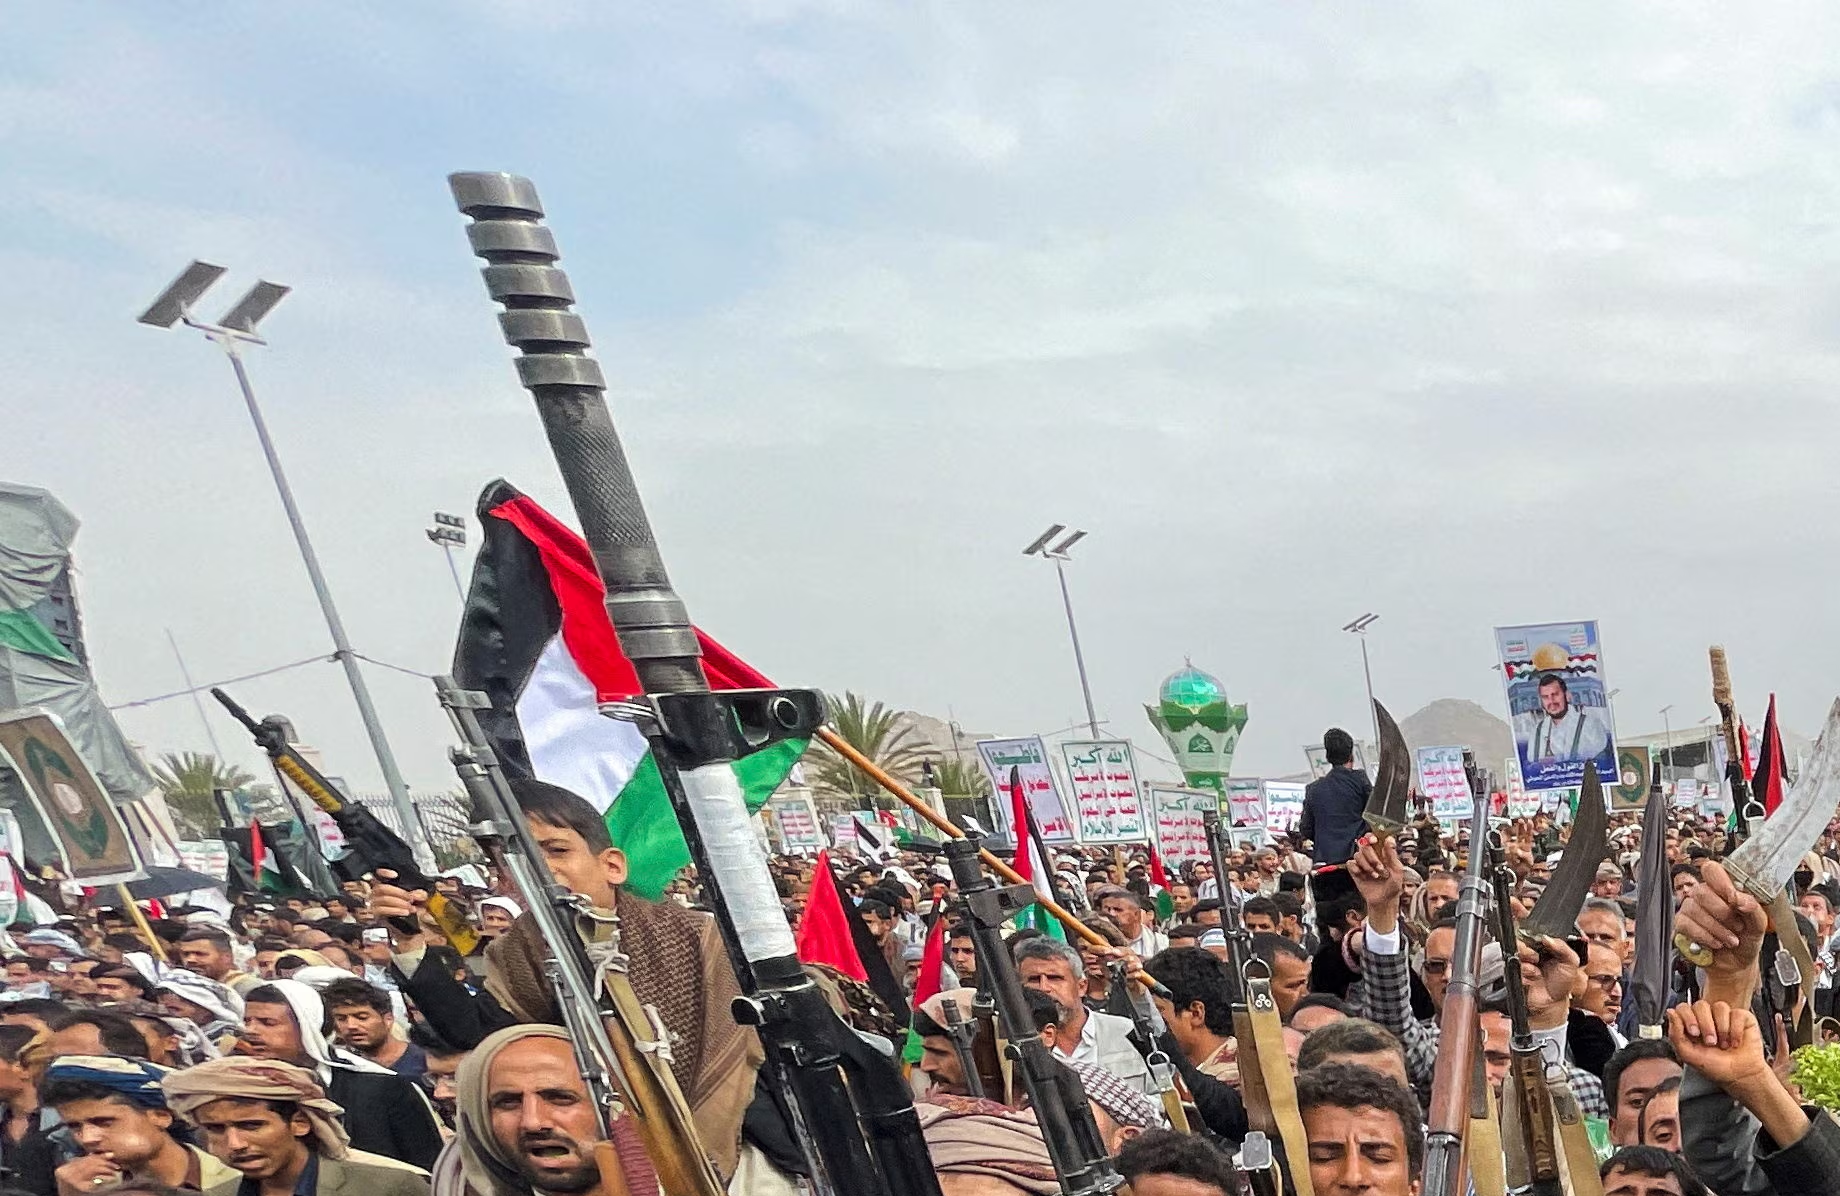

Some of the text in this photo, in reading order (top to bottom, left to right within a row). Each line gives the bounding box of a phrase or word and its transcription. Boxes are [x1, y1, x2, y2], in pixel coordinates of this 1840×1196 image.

[1071, 745, 1128, 768] الله أكبر
[1158, 795, 1190, 814] أكبر
